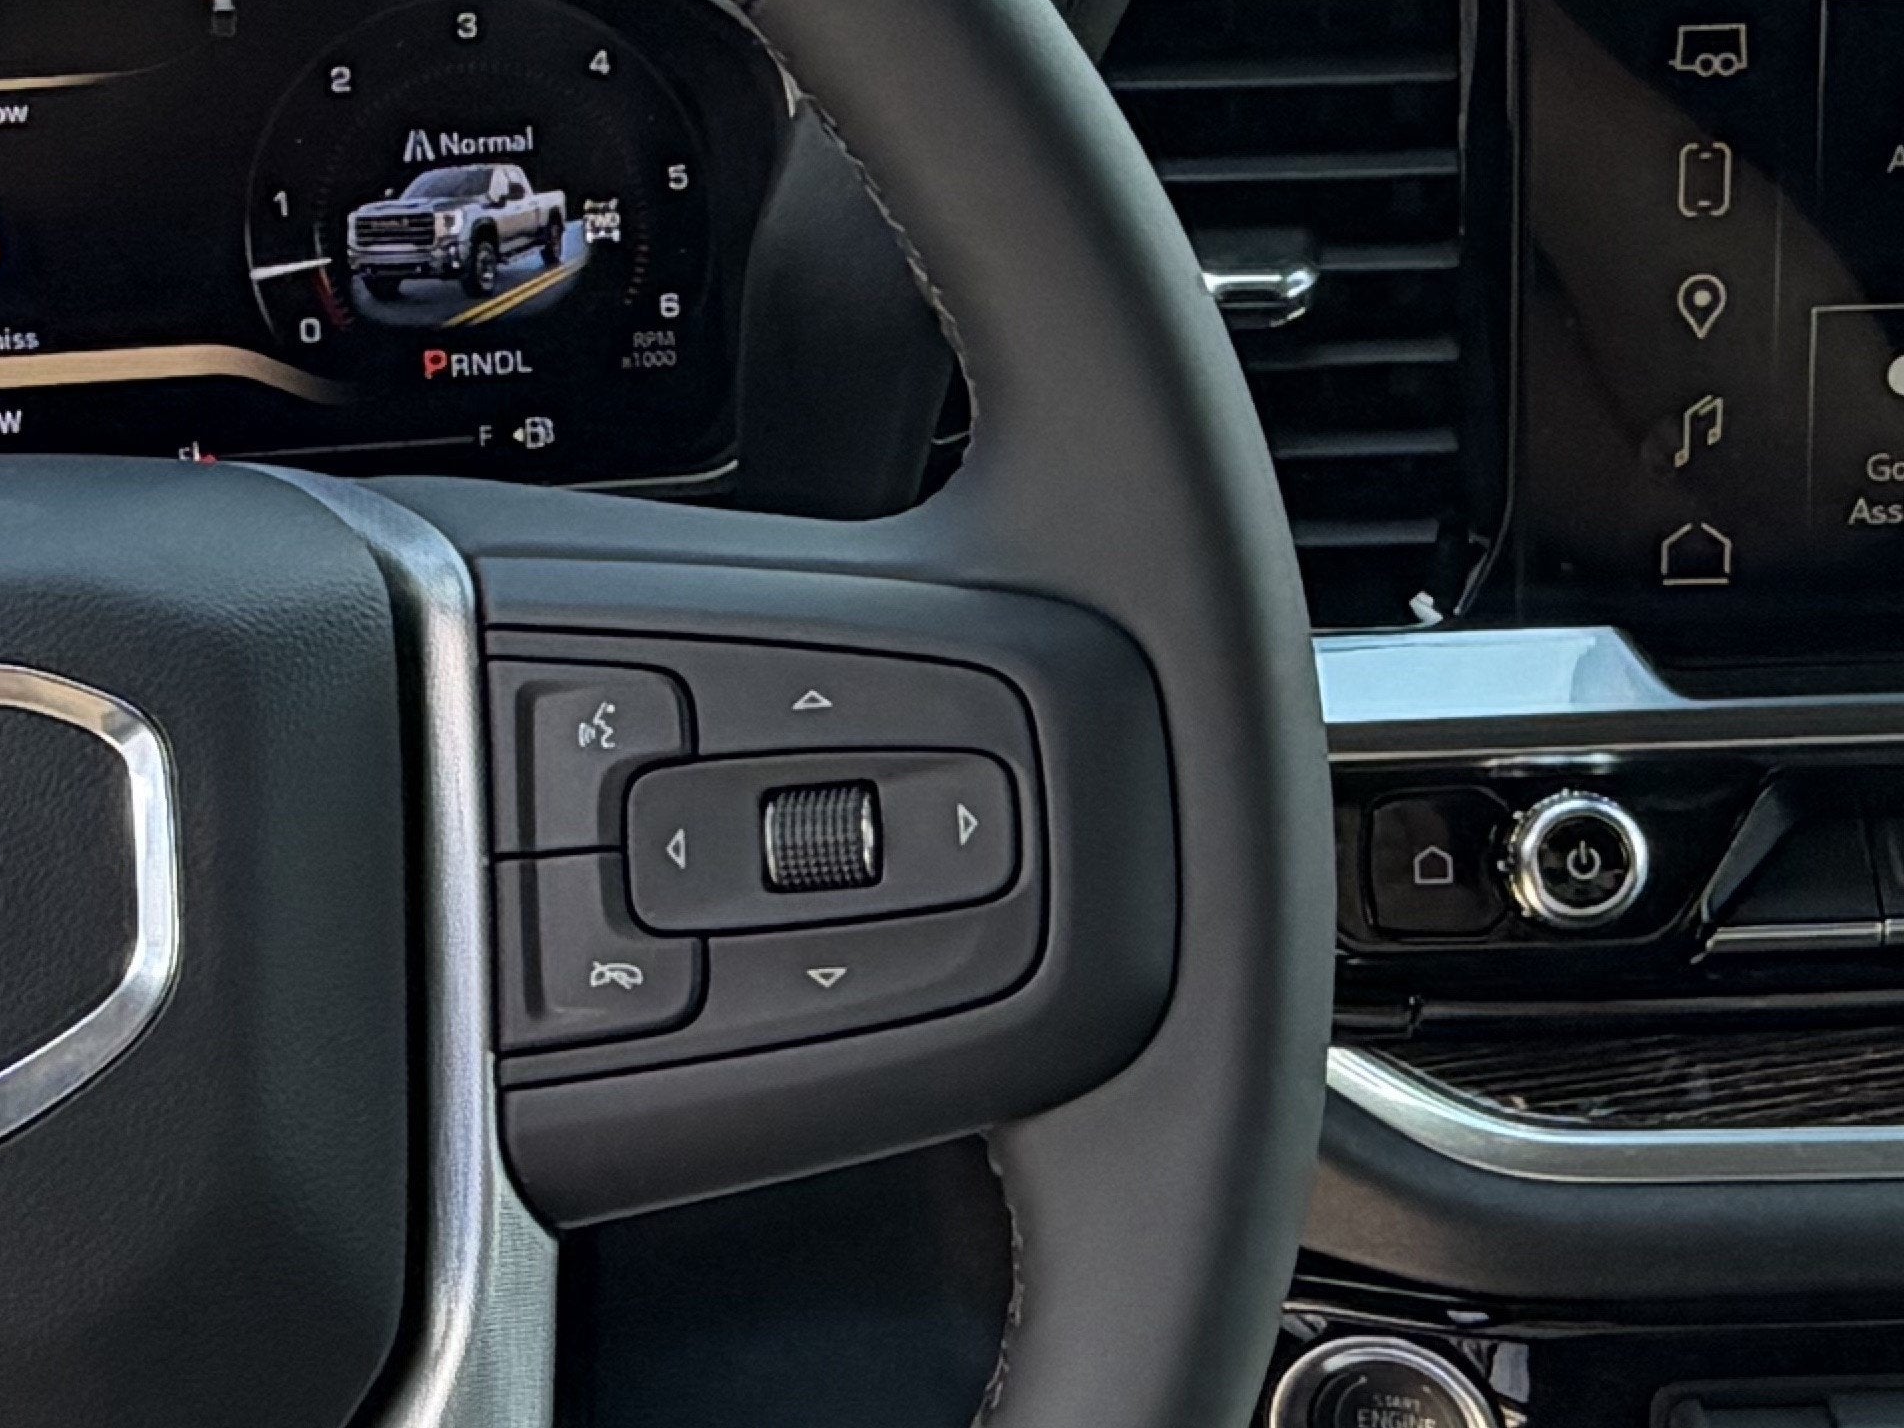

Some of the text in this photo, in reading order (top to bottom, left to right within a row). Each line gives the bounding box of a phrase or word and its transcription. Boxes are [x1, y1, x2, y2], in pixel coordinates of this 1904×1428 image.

[457, 13, 477, 37] 3
[589, 51, 609, 73] 4
[331, 67, 351, 92] 2
[440, 127, 533, 155] Normal
[669, 165, 687, 189] 5
[275, 191, 287, 215] 1
[661, 293, 679, 317] 6
[300, 318, 321, 343] 0
[479, 425, 491, 446] F
